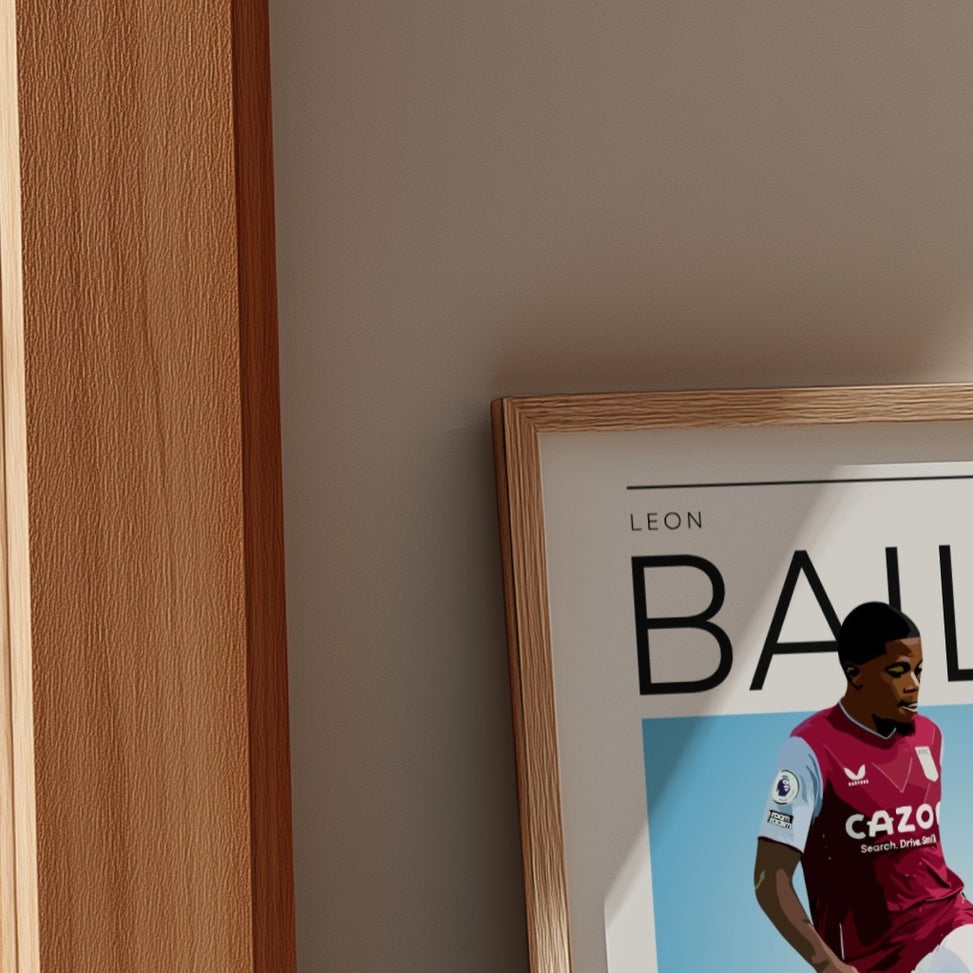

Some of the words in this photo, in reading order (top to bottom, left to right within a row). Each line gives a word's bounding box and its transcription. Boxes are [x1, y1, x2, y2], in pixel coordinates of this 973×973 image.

[630, 511, 703, 532] LEON
[845, 801, 941, 840] CAZO
[860, 841, 898, 853] Search.
